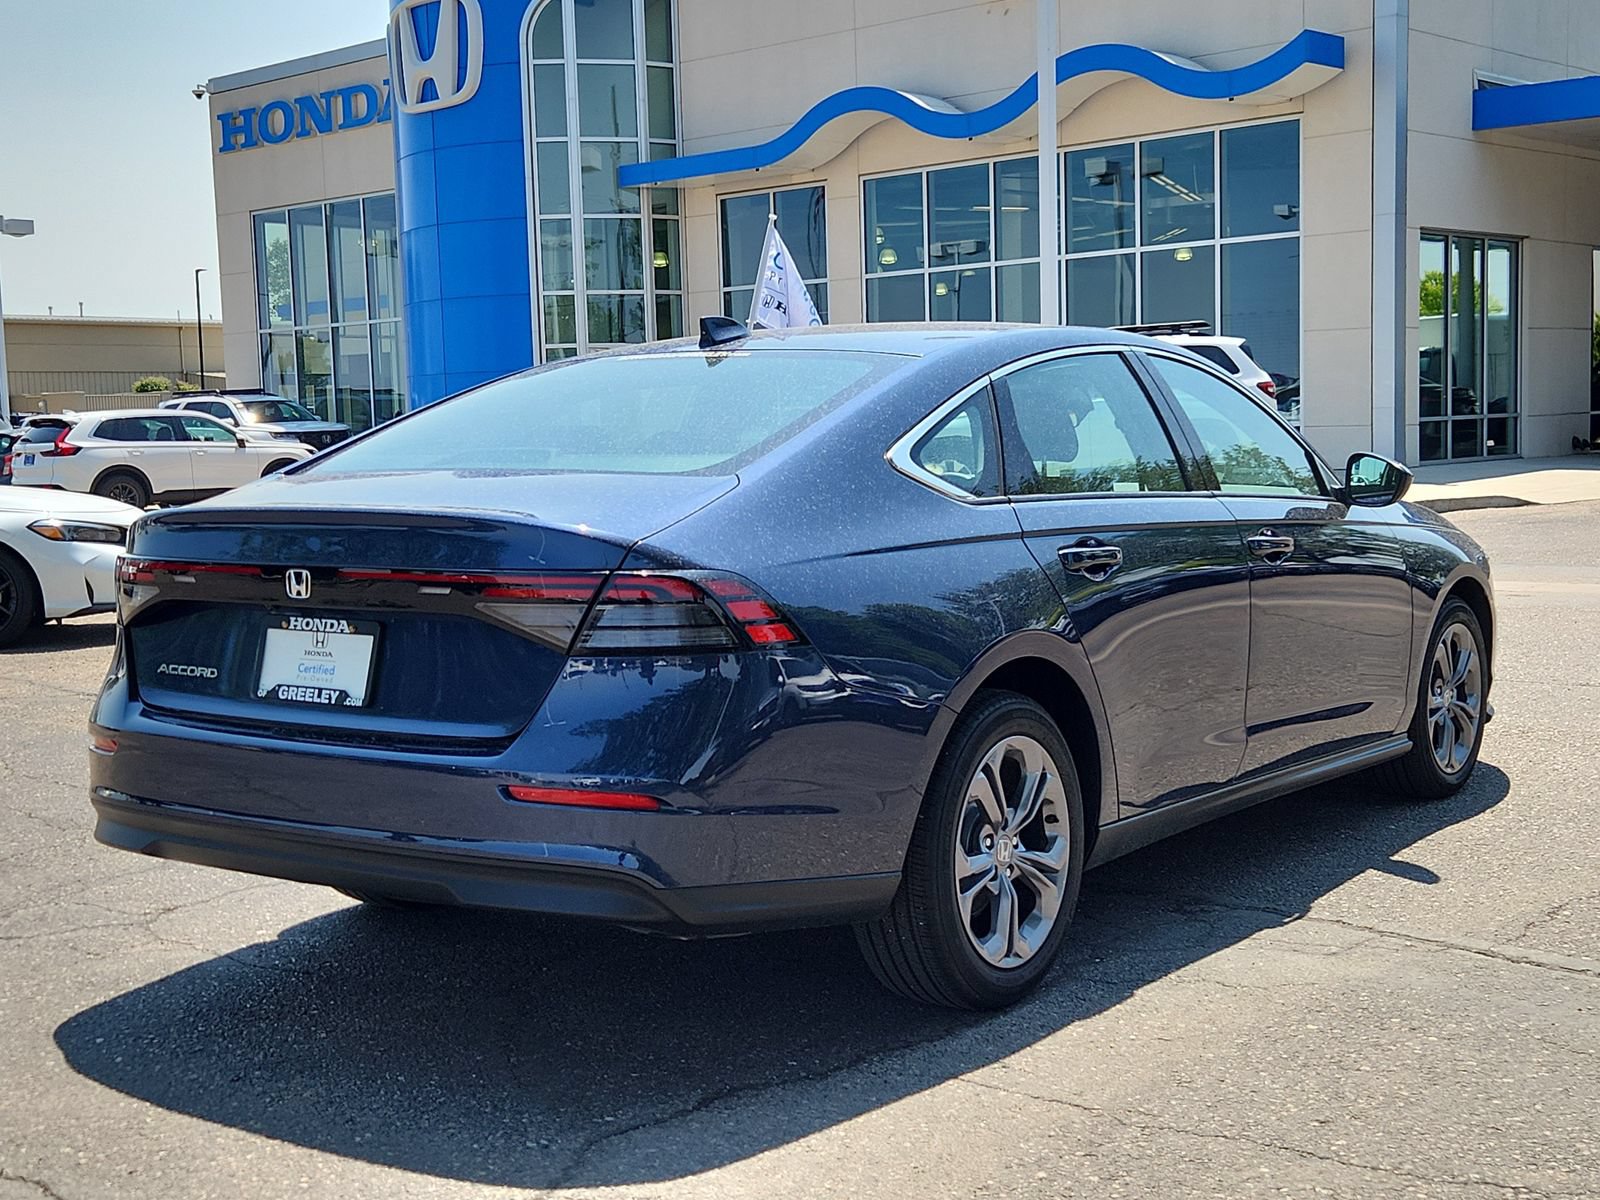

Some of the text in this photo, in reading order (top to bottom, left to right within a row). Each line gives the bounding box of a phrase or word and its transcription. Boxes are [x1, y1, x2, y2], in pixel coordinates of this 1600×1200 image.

[287, 616, 351, 633] HONDA
[304, 649, 333, 658] HONDA
[157, 663, 218, 678] ACCORD
[297, 663, 336, 676] Certified
[278, 685, 340, 705] GREELEY
